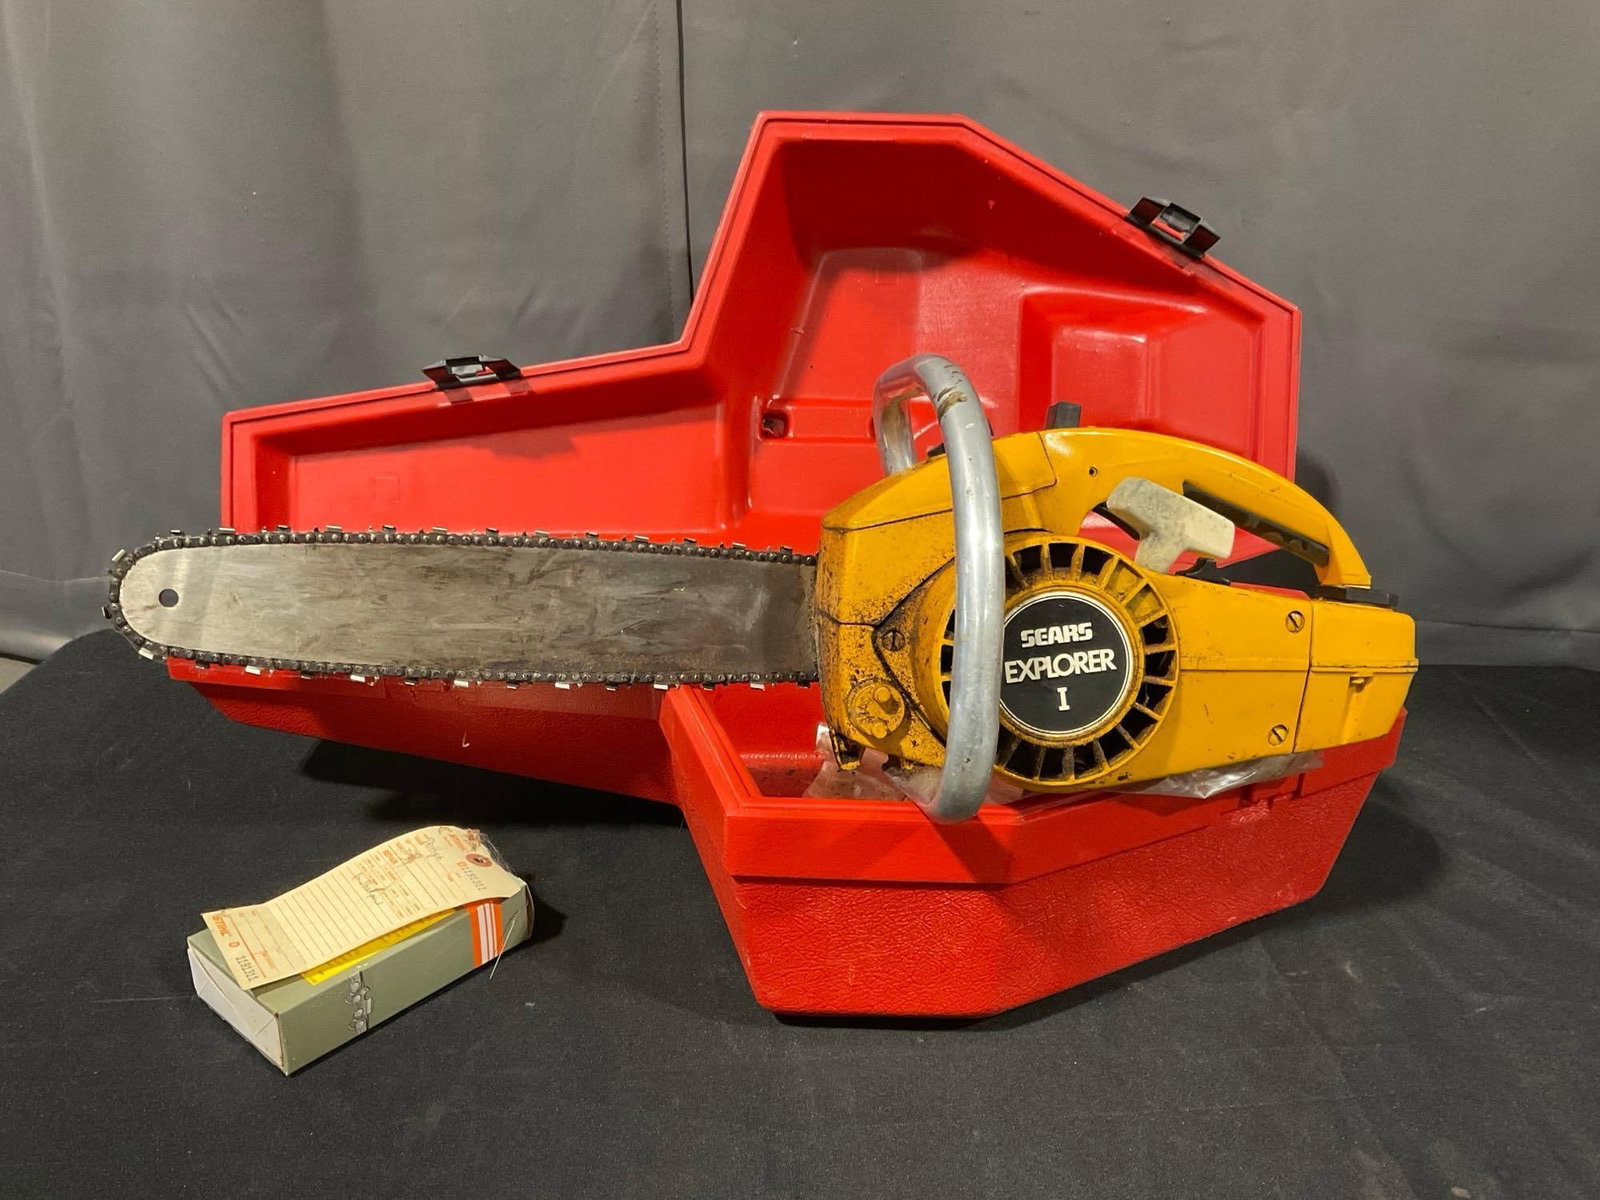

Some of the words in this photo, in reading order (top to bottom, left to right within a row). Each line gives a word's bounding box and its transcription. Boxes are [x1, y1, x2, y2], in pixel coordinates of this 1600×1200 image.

[1020, 622, 1093, 648] SEARS
[1004, 648, 1117, 684] EXPLORER
[1056, 686, 1071, 711] I
